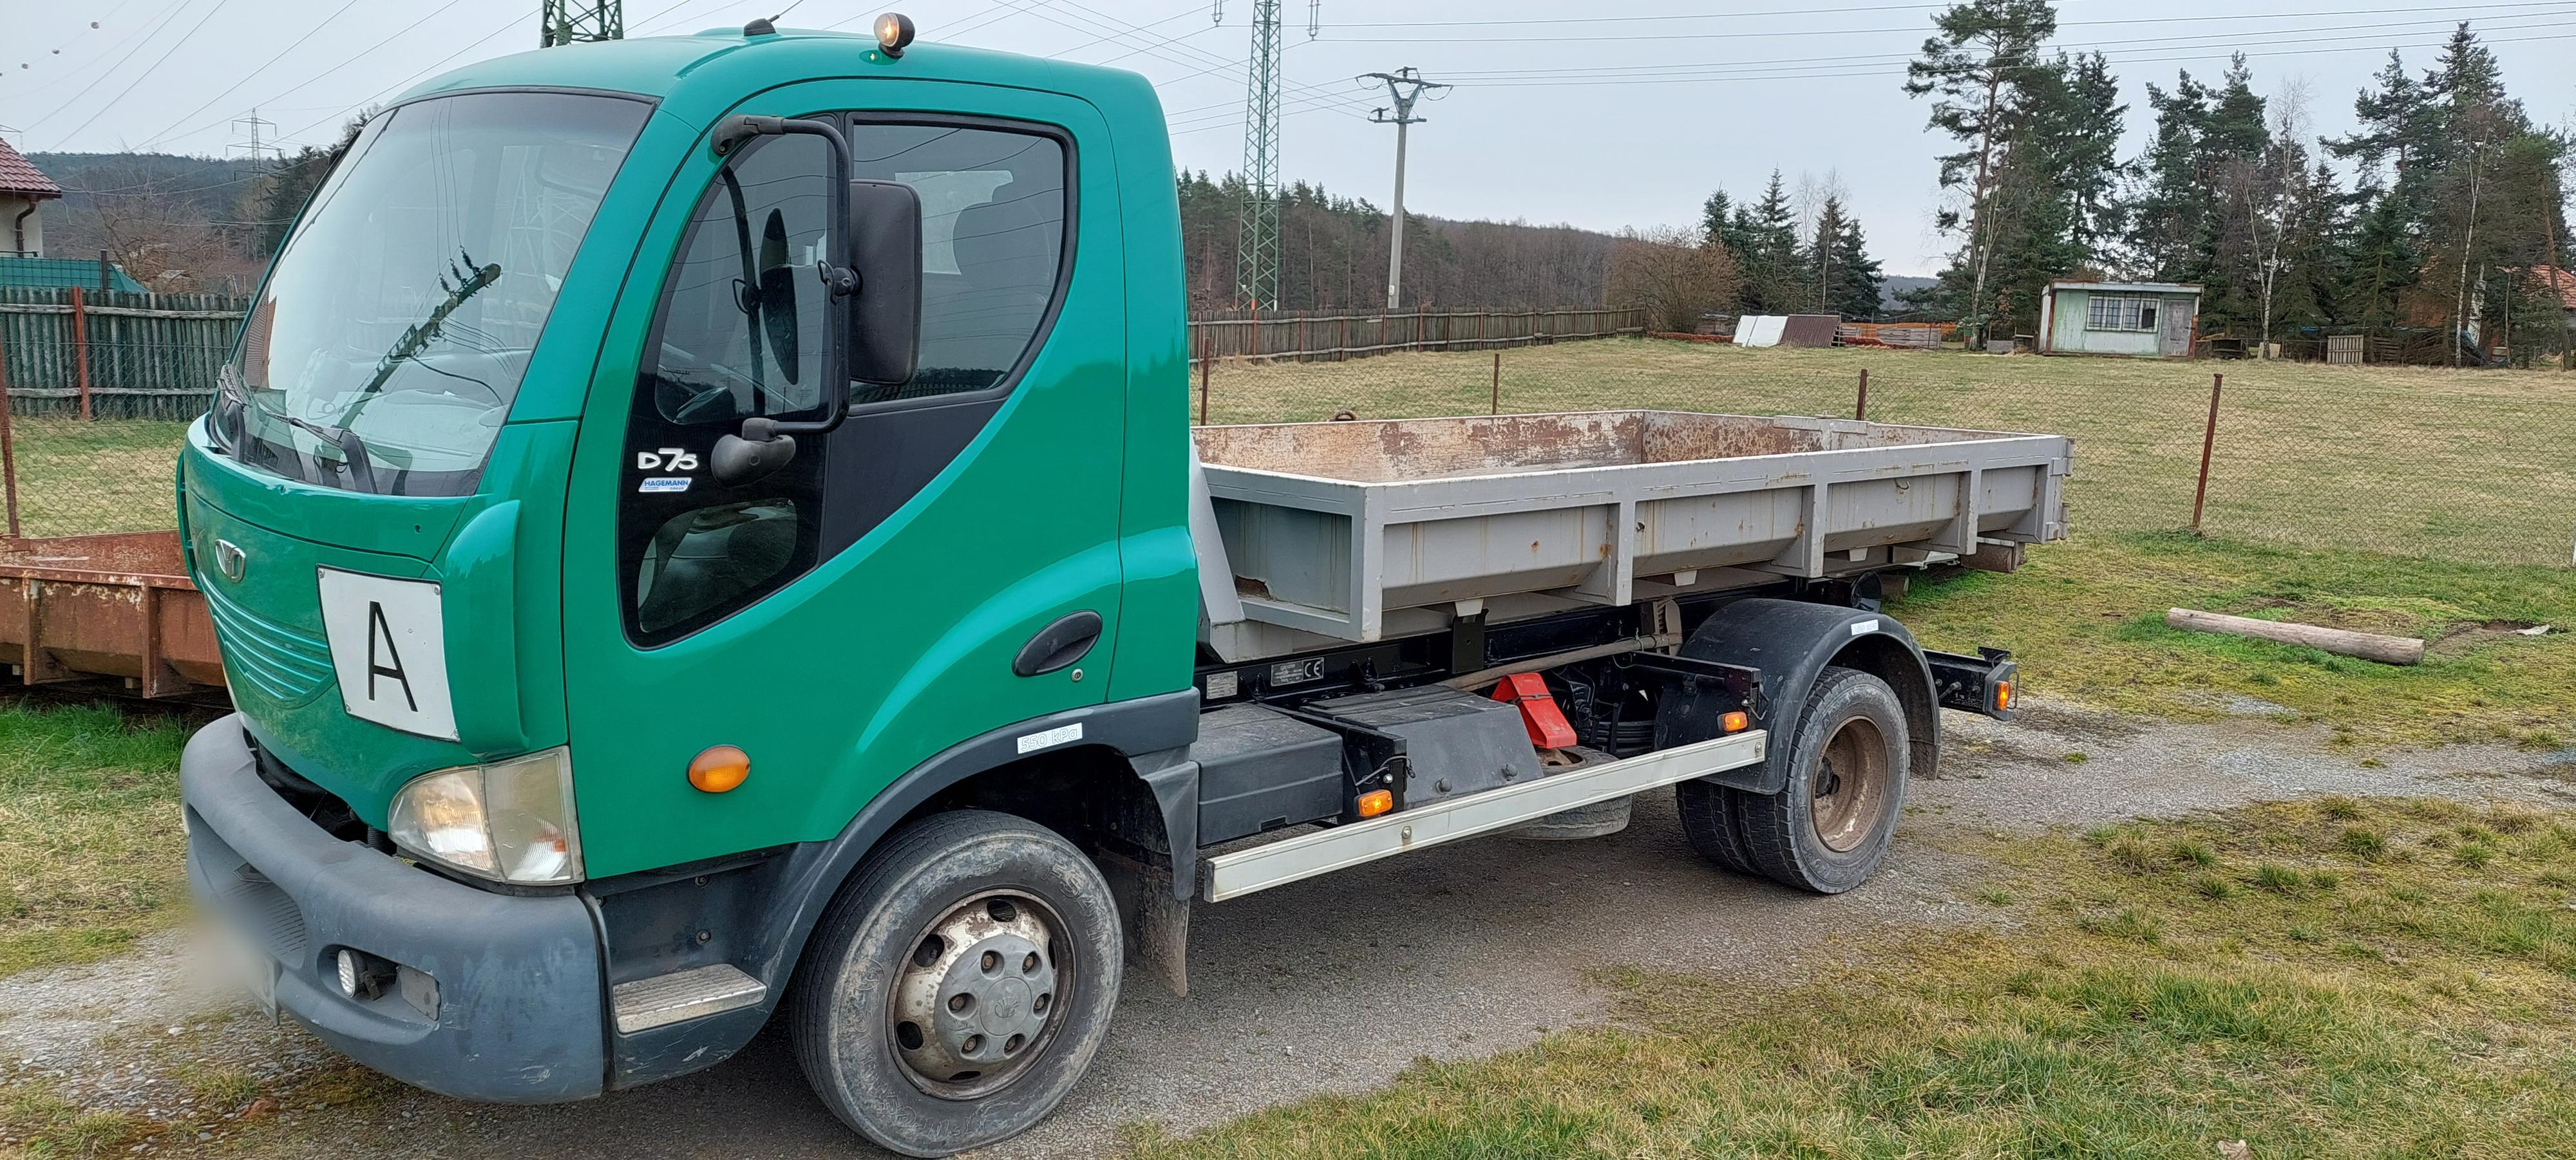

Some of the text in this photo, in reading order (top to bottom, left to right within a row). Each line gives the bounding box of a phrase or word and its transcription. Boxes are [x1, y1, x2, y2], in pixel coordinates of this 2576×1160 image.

[638, 447, 698, 472] D75
[368, 601, 419, 713] A
[1304, 660, 1320, 678] CE
[1021, 728, 1077, 752] 550 kPa
